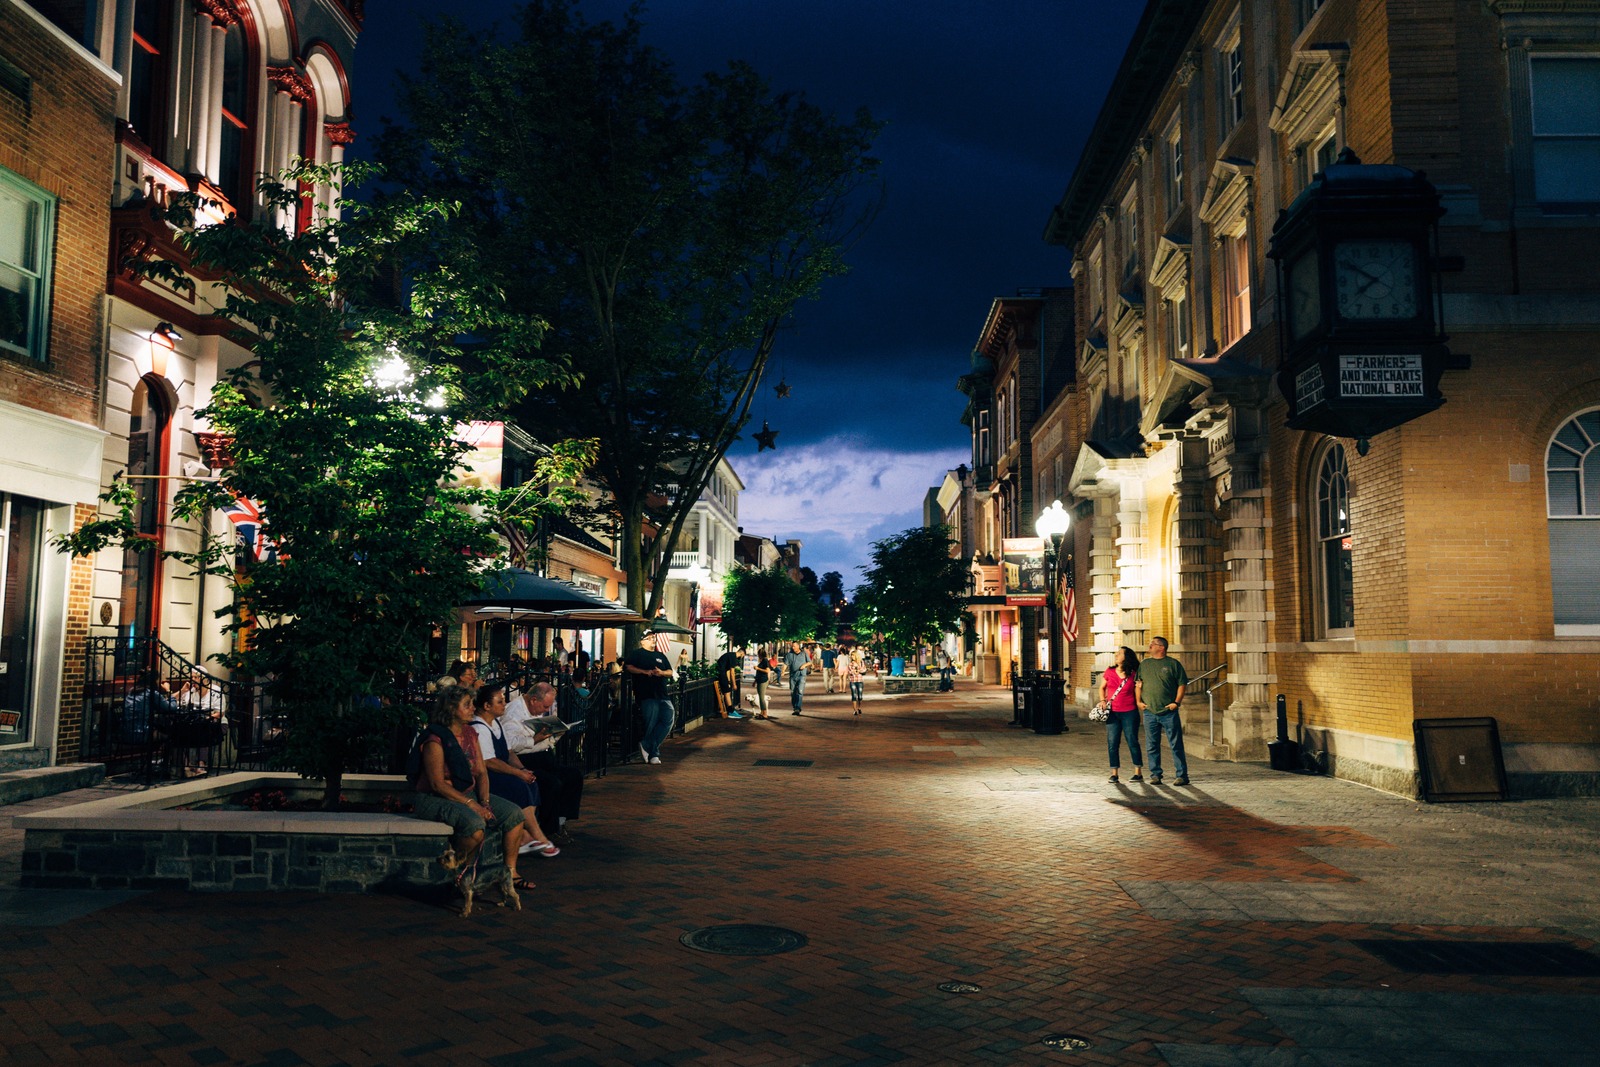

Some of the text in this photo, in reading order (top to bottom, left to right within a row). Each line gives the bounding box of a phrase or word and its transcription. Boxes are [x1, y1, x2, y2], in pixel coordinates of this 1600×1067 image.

[1351, 248, 1360, 259] 11
[1368, 247, 1380, 258] 12
[1389, 248, 1394, 259] 1
[1403, 257, 1410, 268] 2
[1339, 275, 1346, 287] 9
[1340, 294, 1348, 304] 8
[1355, 304, 1362, 315] 7
[1373, 303, 1380, 314] 6
[1392, 303, 1399, 314] 5
[1341, 370, 1421, 381] AND MERCHANTS
[1342, 383, 1422, 394] NATIONAL BANK
